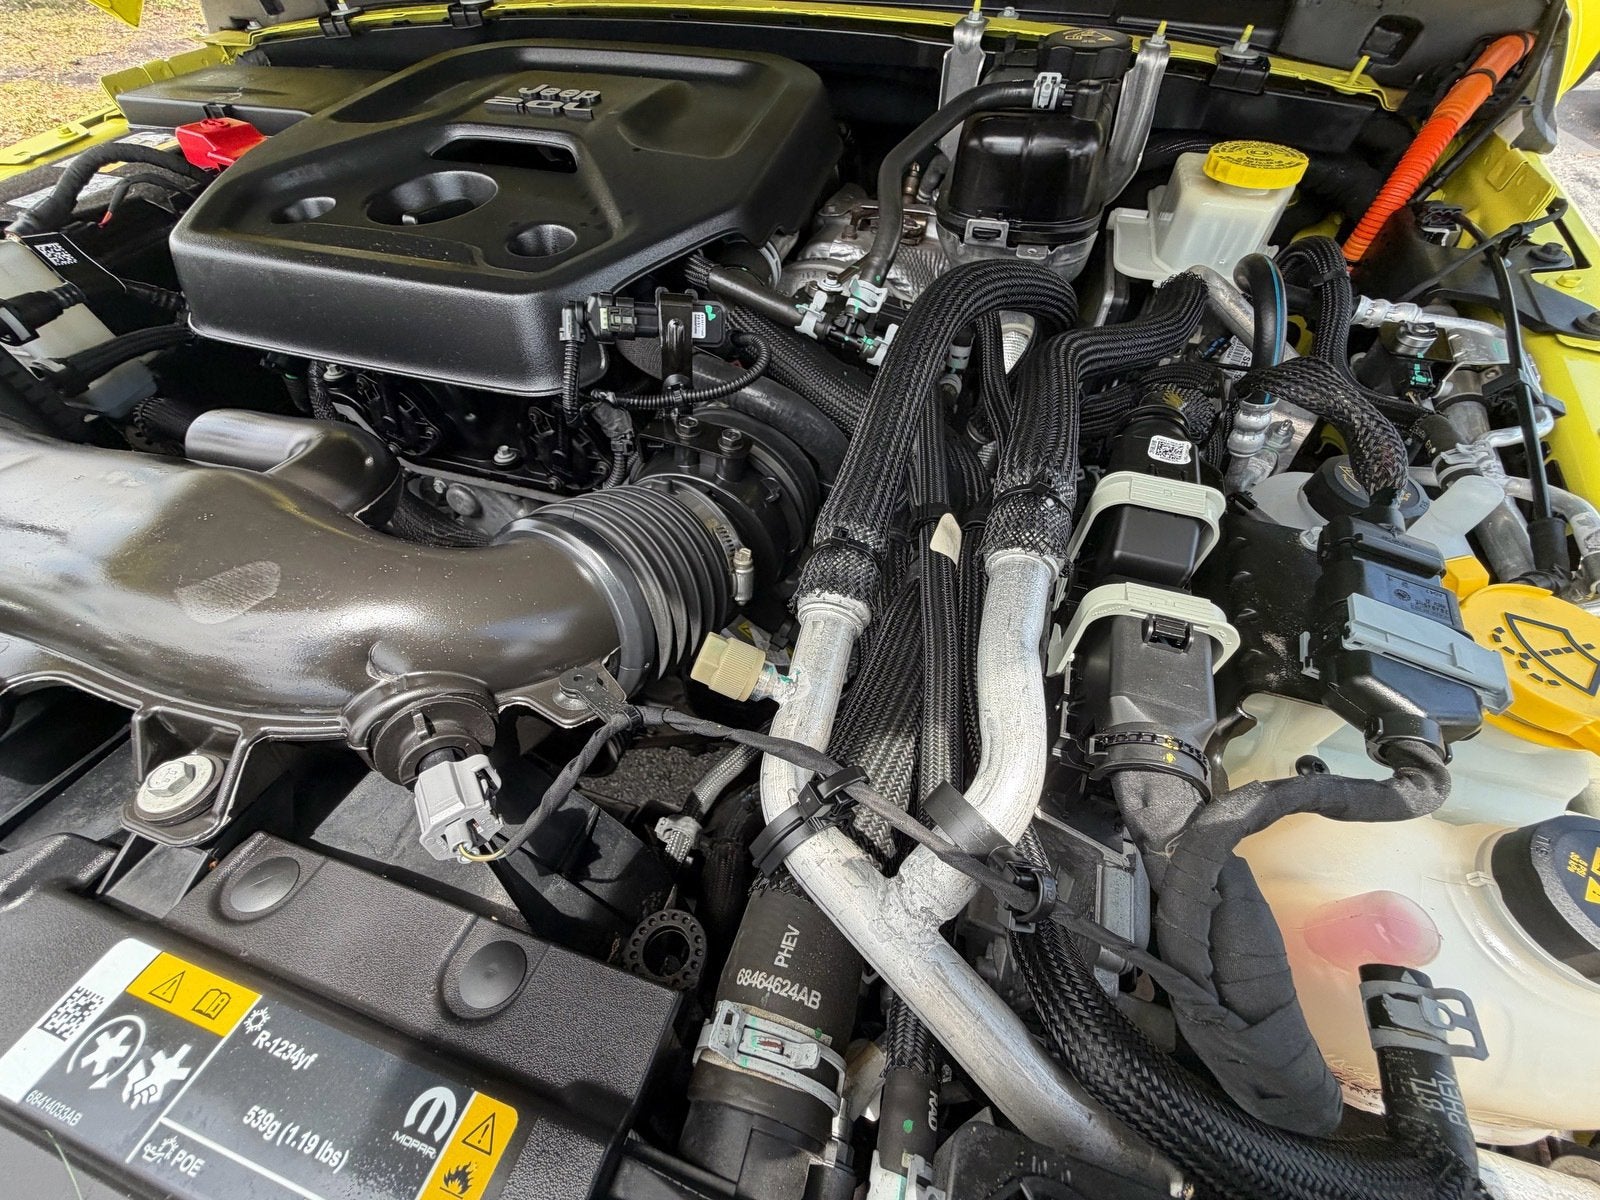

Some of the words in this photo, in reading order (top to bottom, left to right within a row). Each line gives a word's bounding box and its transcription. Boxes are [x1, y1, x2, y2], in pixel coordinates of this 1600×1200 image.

[518, 84, 601, 104] Jeep
[773, 924, 800, 968] PHEV
[736, 967, 822, 1010] 68464624AB
[252, 1030, 319, 1071] R-1234yf
[25, 1089, 84, 1127] 68414033AB
[1409, 1076, 1445, 1113] BTL
[1434, 1070, 1468, 1128] PHEV
[242, 1105, 282, 1141] 539g
[276, 1122, 320, 1154] (1.19
[314, 1139, 350, 1175] lbs)
[170, 1150, 206, 1178] POE
